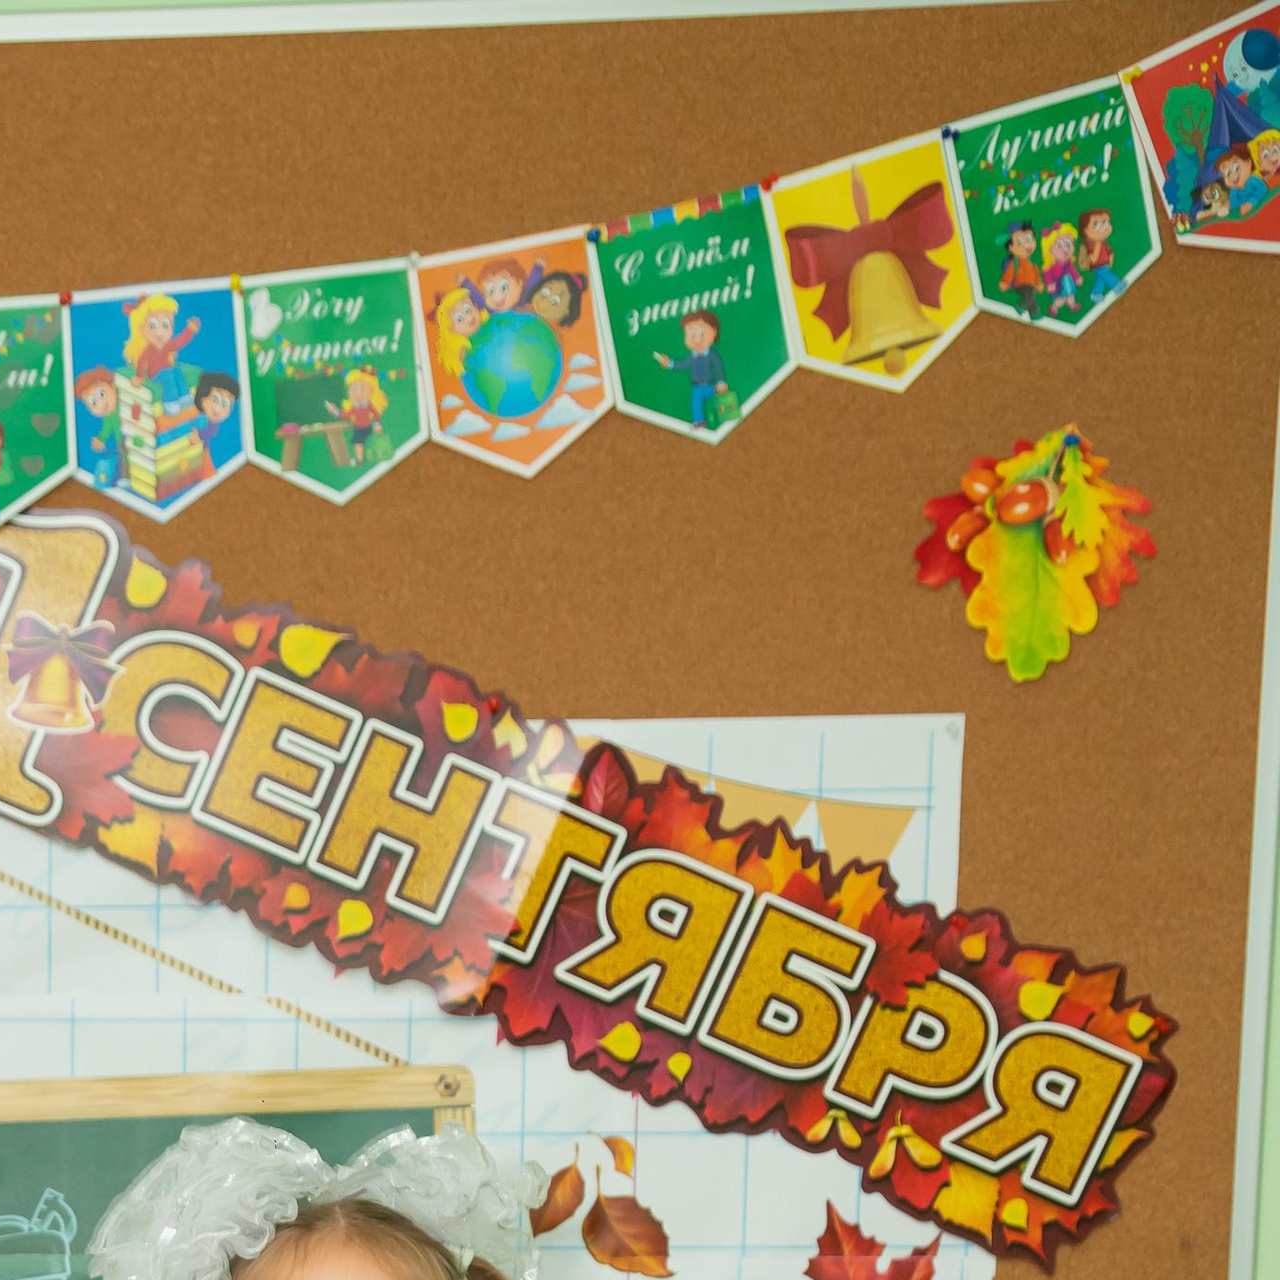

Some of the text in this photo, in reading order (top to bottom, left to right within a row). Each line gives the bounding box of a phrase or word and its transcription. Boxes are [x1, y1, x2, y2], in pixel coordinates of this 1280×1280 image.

[958, 93, 1127, 171] Лучший
[993, 142, 1113, 215] класс!
[614, 233, 751, 286] С Днём
[285, 286, 365, 325] Хочу
[626, 263, 756, 337] знаний!
[256, 316, 404, 377] учиться!
[98, 628, 1142, 1207] СЕНТЯБРЯ
